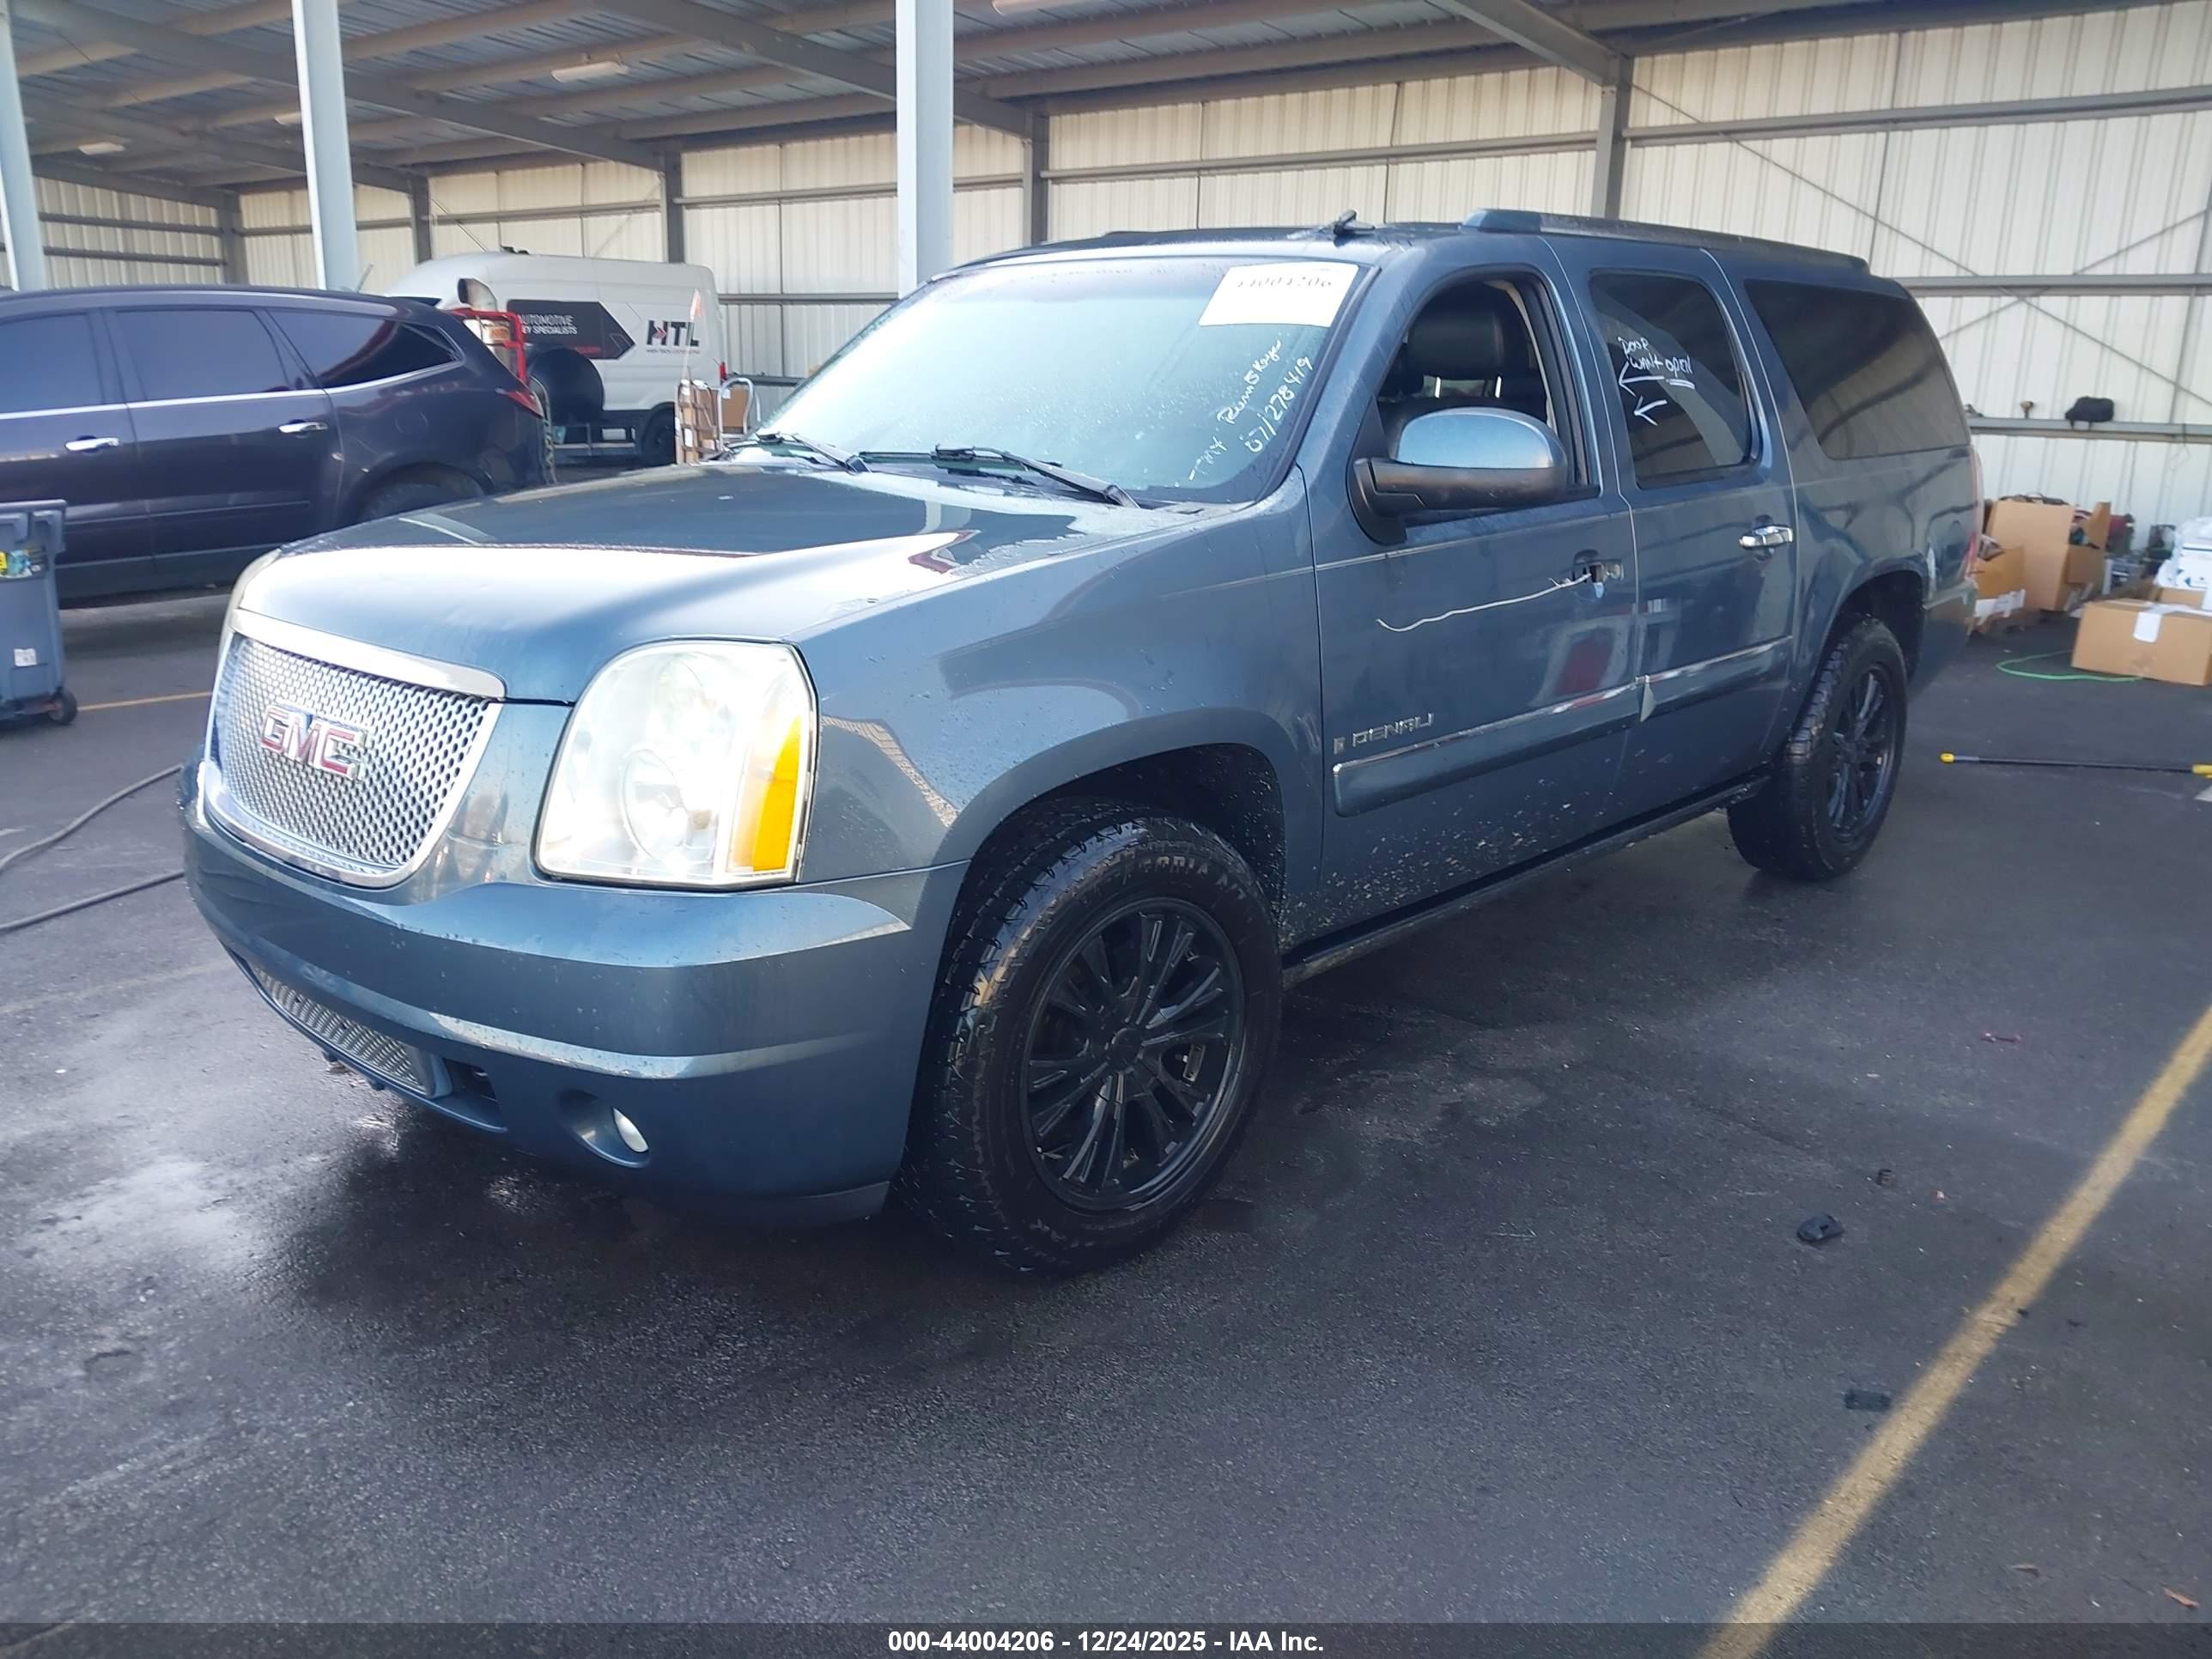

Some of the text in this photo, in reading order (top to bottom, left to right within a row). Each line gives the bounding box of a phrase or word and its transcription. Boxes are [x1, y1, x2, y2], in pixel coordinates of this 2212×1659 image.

[647, 319, 699, 346] HTL
[260, 704, 368, 781] GMC
[1352, 713, 1434, 747] DENALI
